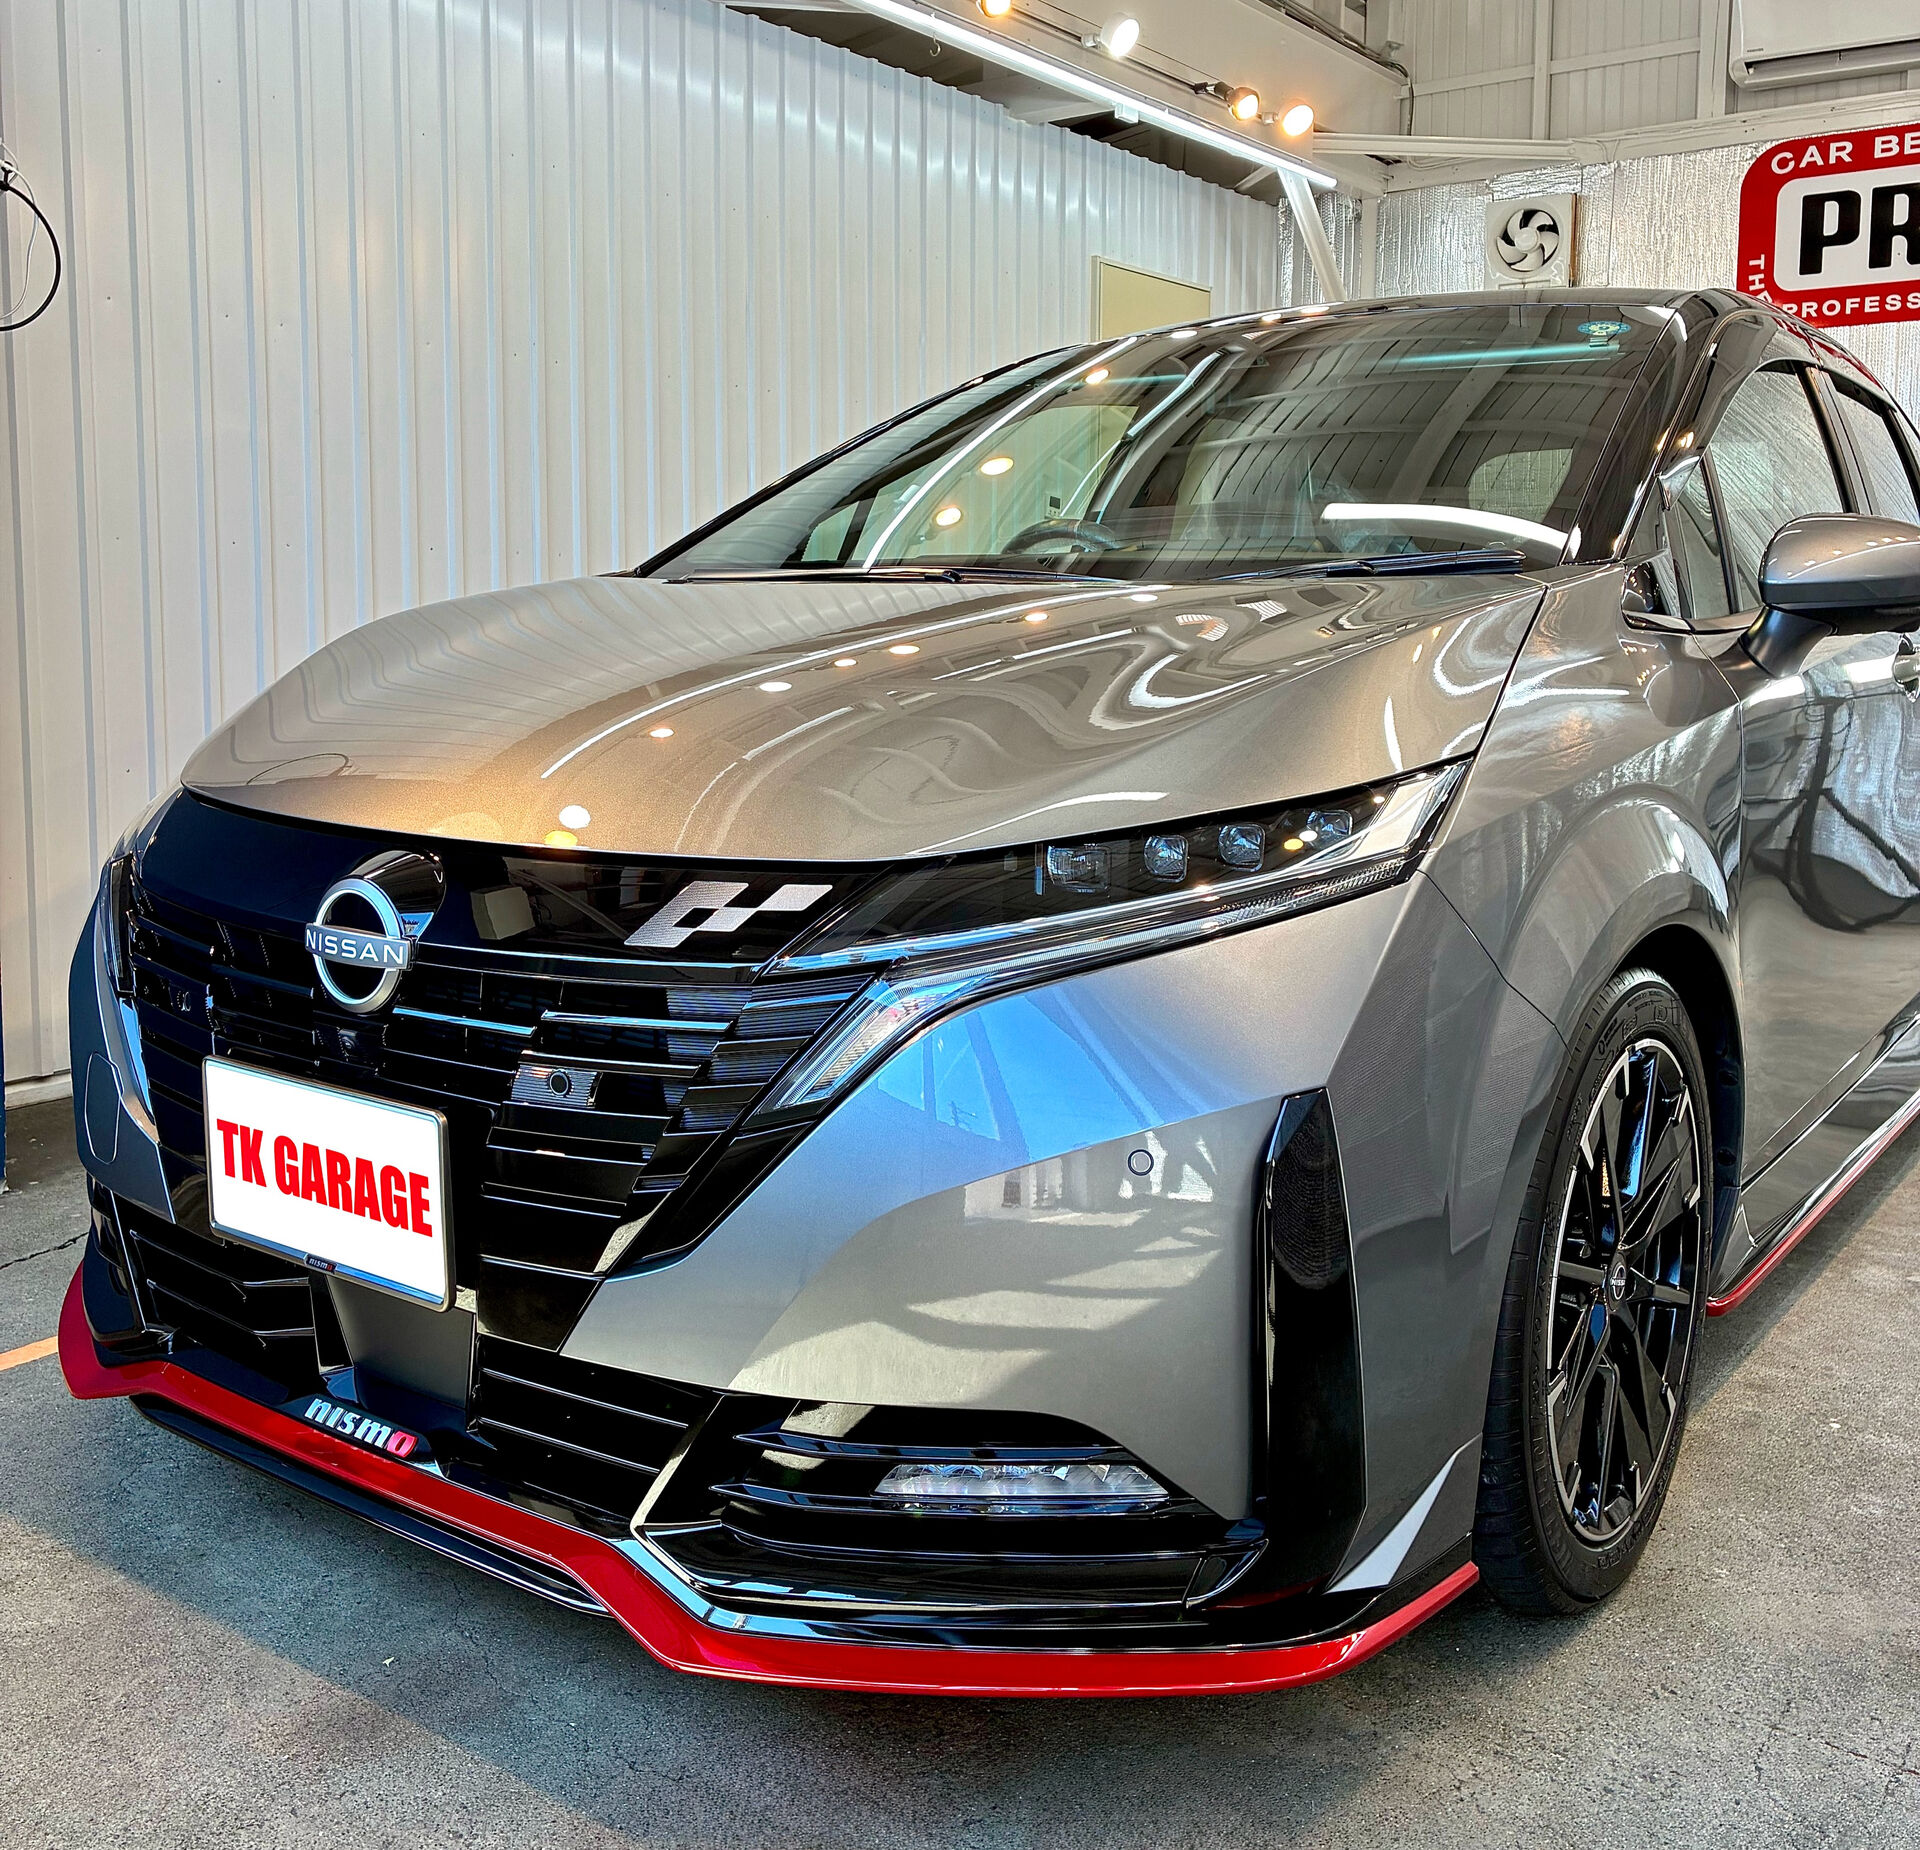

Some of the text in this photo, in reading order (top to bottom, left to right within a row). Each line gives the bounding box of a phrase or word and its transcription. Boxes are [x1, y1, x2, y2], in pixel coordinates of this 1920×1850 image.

[1770, 131, 1920, 174] CAR BE
[1798, 182, 1920, 275] PR
[305, 928, 405, 965] NISSAN
[216, 1118, 433, 1238] TK GARAGE
[309, 1257, 334, 1271] nismo
[304, 1398, 418, 1458] nismo
